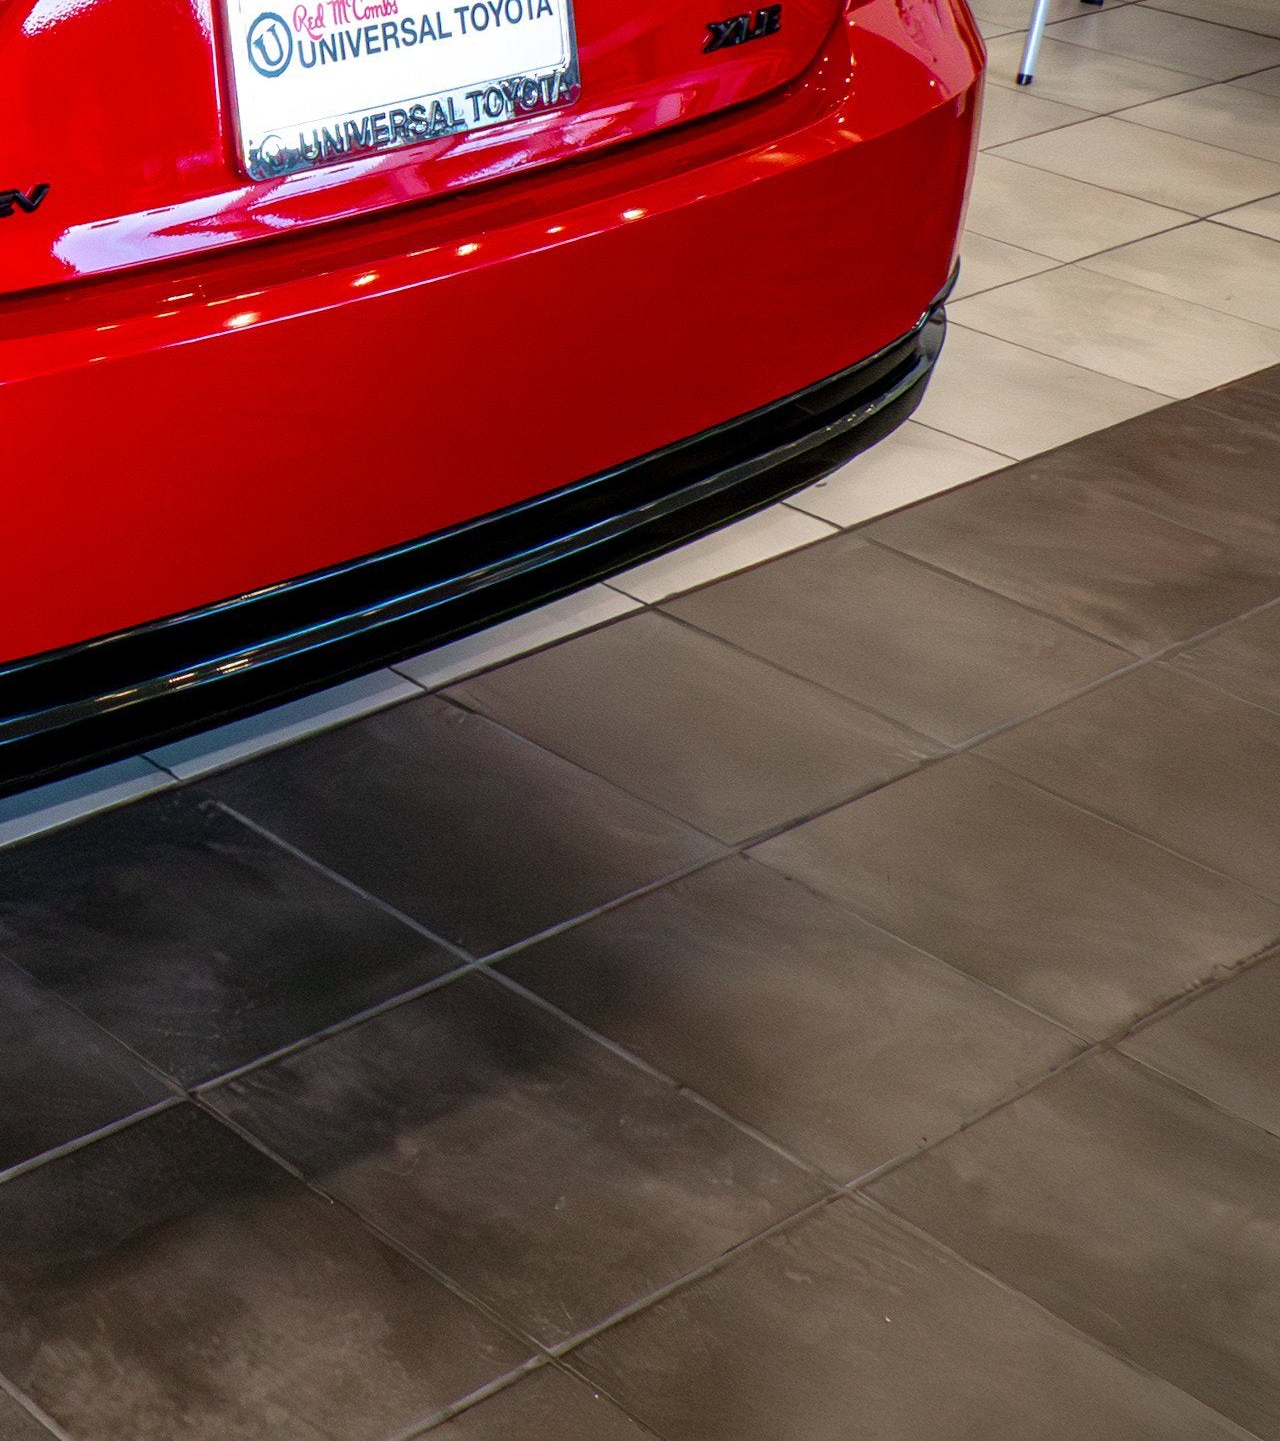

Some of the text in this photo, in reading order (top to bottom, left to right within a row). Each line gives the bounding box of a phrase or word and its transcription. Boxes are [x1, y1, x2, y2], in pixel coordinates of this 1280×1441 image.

[293, 2, 324, 42] Red
[297, 10, 453, 69] UNIVERSAL
[298, 96, 465, 162] UNIVERSAL
[465, 69, 572, 123] TOYOTA
